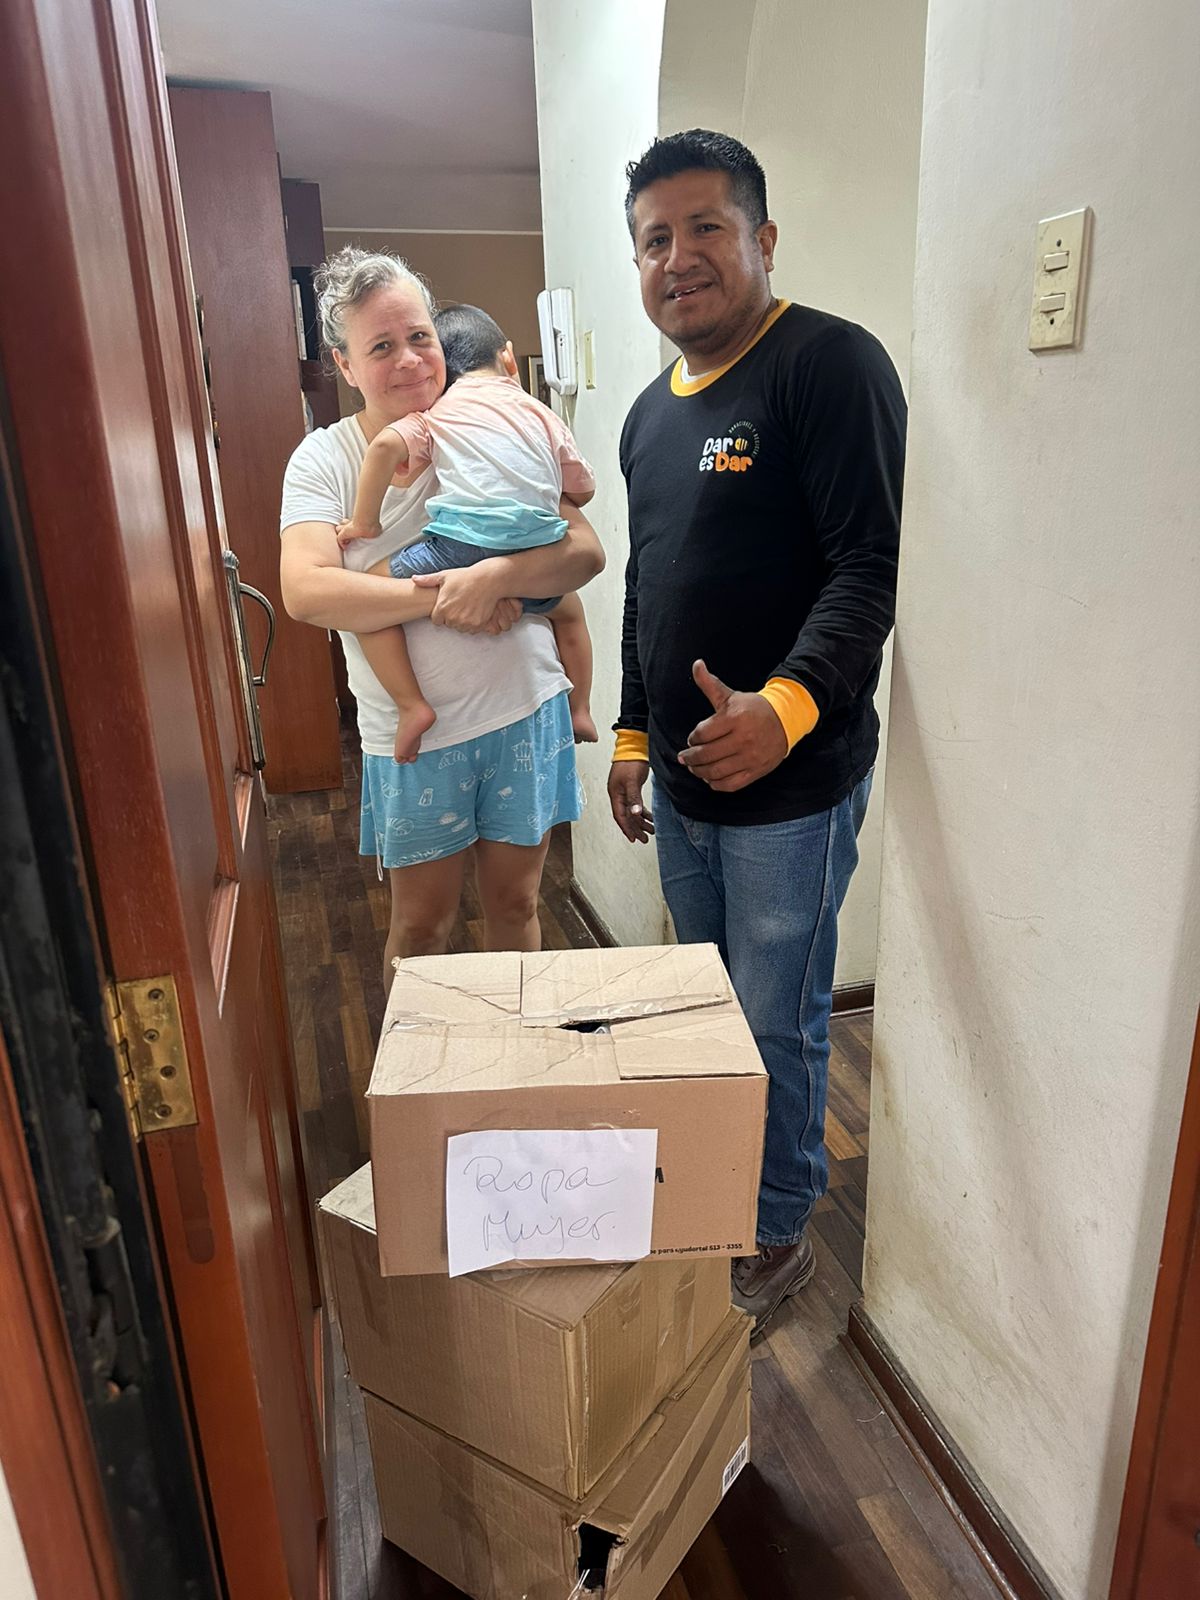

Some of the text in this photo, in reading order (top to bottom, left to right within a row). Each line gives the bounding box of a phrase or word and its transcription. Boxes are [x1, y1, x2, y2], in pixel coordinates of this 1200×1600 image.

[702, 437, 734, 456] Dar
[699, 451, 753, 472] es Dar
[463, 1155, 620, 1205] Ropa
